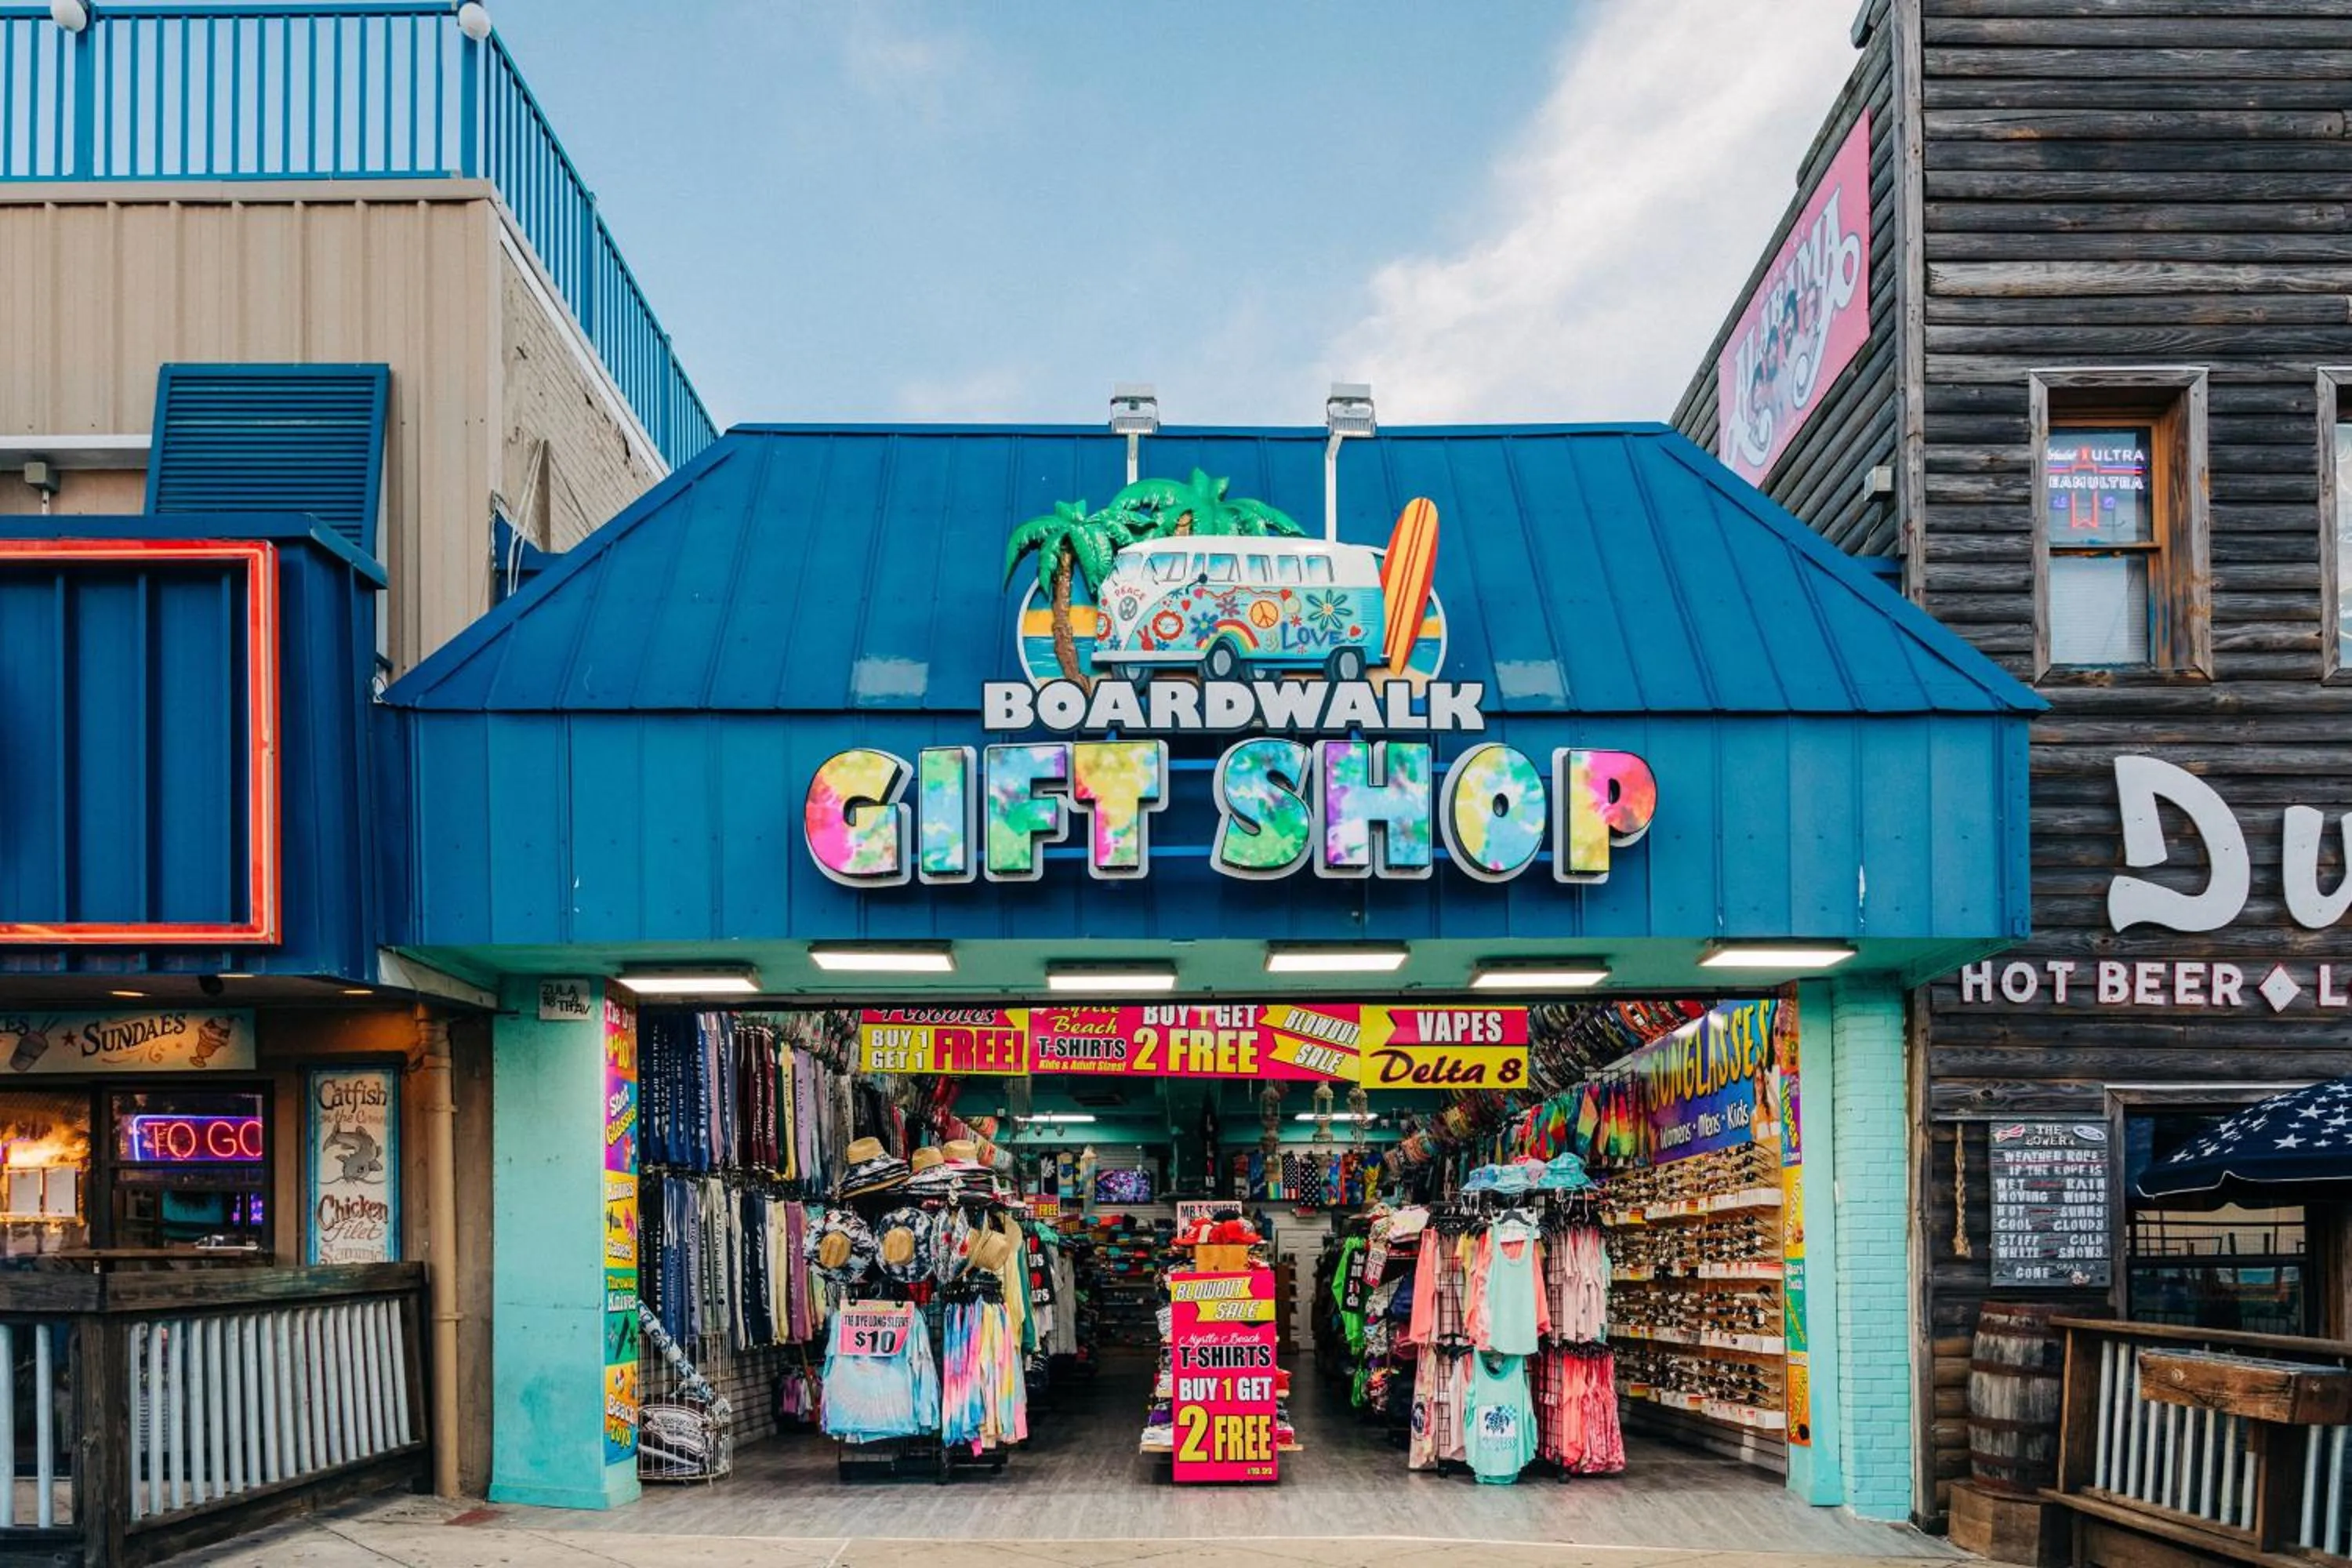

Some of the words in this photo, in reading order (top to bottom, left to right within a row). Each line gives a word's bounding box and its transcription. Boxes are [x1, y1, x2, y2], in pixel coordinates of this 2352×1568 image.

[2091, 449, 2144, 462] ULTRA
[1114, 586, 1146, 601] PEACE
[1281, 621, 1343, 650] LOVE
[984, 680, 1486, 731] BOARDWALK
[804, 739, 1169, 887] GIFT
[1212, 739, 1658, 884] SHOP
[1962, 961, 2074, 1004] HOT
[2097, 961, 2243, 1006] BEER
[2318, 964, 2352, 1007] L
[1049, 1016, 1117, 1034] Beach
[1142, 1005, 1189, 1025] BUY
[1215, 1005, 1258, 1028] GET
[1283, 1008, 1360, 1045] BLOWOUT
[1417, 1011, 1503, 1043] VAPES
[0, 1014, 30, 1037] ES
[81, 1011, 187, 1057] SUNDAES
[871, 1029, 912, 1049] BUY
[919, 1029, 929, 1049] 1
[934, 1028, 1025, 1071] FREE!
[1036, 1036, 1127, 1058] T-SHIRTS
[1133, 1027, 1159, 1070] 2
[1167, 1029, 1259, 1073] FREE
[1294, 1043, 1345, 1073] SALE
[1649, 999, 1769, 1112] SUNGLASSES
[871, 1051, 909, 1069] GET
[915, 1051, 925, 1069] 1
[1370, 1049, 1486, 1084] Delta
[1497, 1058, 1523, 1084] 8
[317, 1079, 387, 1113] Catfish
[1697, 1112, 1721, 1138] Mens
[1726, 1098, 1750, 1131] Kids
[2034, 1124, 2063, 1135] THE
[144, 1122, 196, 1159] TO
[208, 1120, 263, 1158] GO
[2004, 1150, 2063, 1163] WEATHER
[2066, 1150, 2099, 1162] ROPE
[2026, 1164, 2049, 1175] THE
[2089, 1163, 2103, 1176] IS
[1996, 1178, 2025, 1189] WET
[2066, 1178, 2106, 1189] RAIN
[317, 1193, 389, 1231] Chicken
[1997, 1204, 2025, 1216] HOT
[2060, 1205, 2104, 1218] SUNNY
[1998, 1218, 2032, 1230] COOL
[2053, 1218, 2104, 1232] CLOUDY
[1998, 1235, 2039, 1245] STIFF
[2069, 1233, 2103, 1245] COLD
[1998, 1246, 2040, 1258] WHITE
[2058, 1247, 2104, 1258] SNOWY
[2016, 1267, 2050, 1279] GONE
[1176, 1281, 1244, 1301] BLOWOUT
[1215, 1302, 1260, 1319] SALE
[855, 1330, 896, 1353] $10
[1178, 1333, 1218, 1348] Myrtle
[1221, 1332, 1261, 1345] Beach
[1178, 1345, 1271, 1369] T-SHIRTS
[1178, 1377, 1218, 1401] BUY
[1221, 1377, 1232, 1401] 1
[1236, 1377, 1272, 1401] GET
[1178, 1404, 1209, 1462] 2
[1214, 1414, 1272, 1461] FREE
